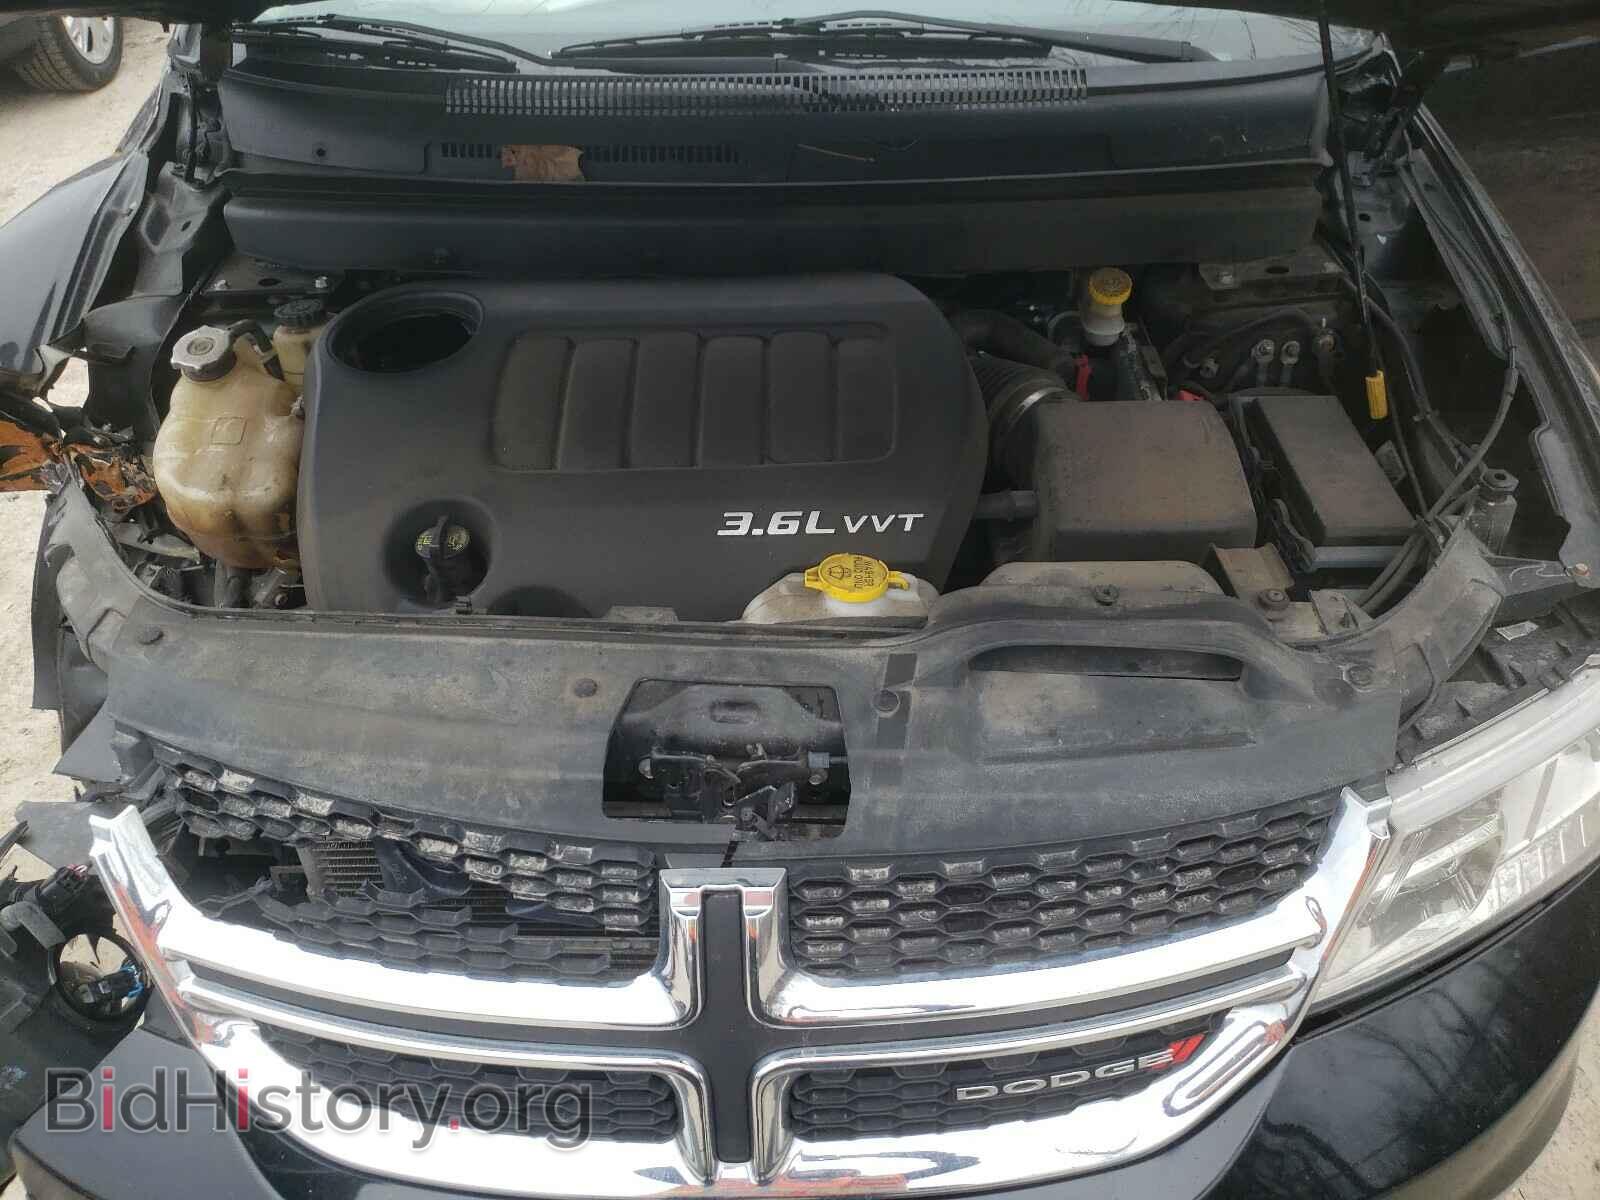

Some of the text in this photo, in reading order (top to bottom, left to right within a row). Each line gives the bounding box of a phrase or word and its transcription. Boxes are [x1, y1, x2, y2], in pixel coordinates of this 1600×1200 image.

[716, 510, 925, 536] 3.6L VVT
[956, 1048, 1175, 1101] DODGE
